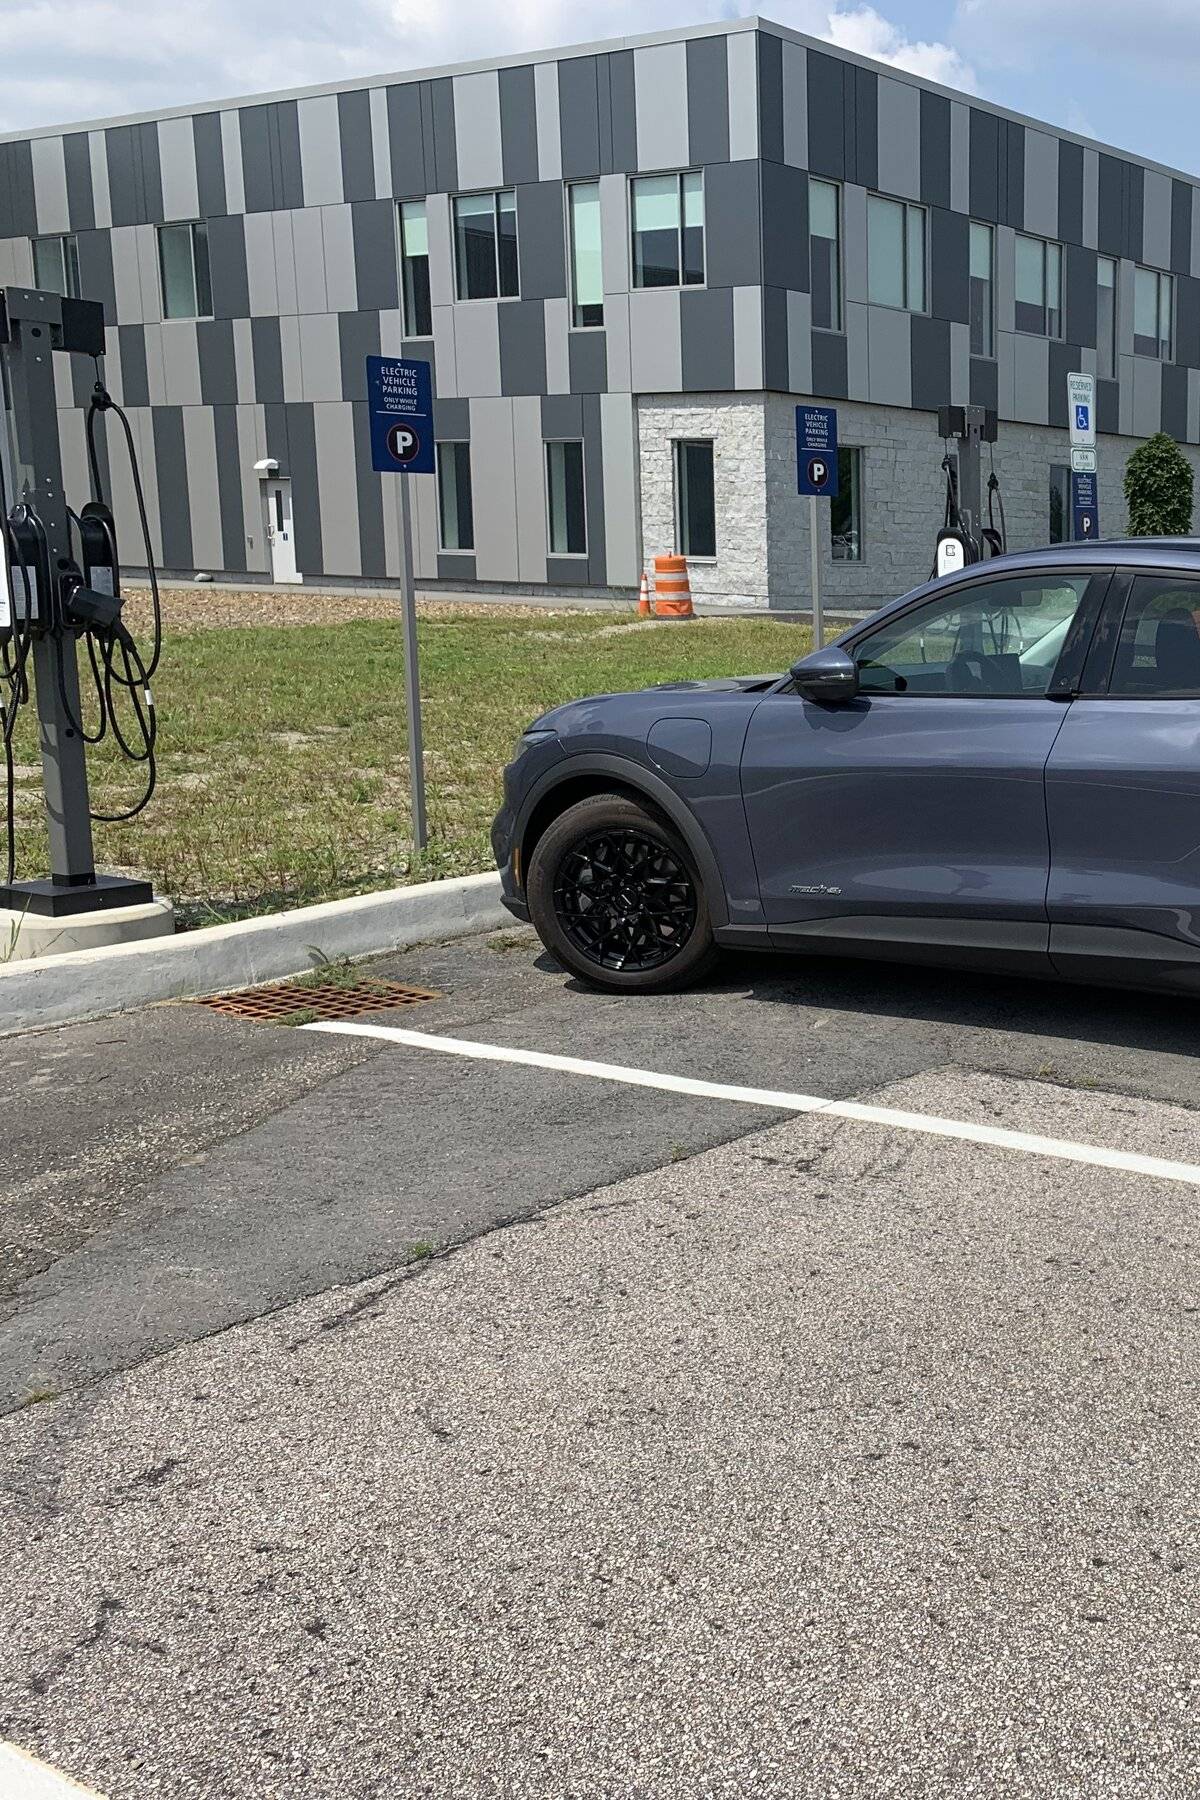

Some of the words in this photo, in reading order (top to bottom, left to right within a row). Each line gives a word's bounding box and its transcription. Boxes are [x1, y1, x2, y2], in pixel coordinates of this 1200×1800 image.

[381, 367, 417, 377] ELECTRIC
[383, 376, 416, 386] VEHICLE
[1070, 381, 1091, 391] RESERVED
[382, 385, 417, 396] PARKING
[1072, 393, 1090, 403] PARKING
[396, 431, 413, 454] P
[814, 464, 824, 481] P
[1083, 518, 1090, 532] P
